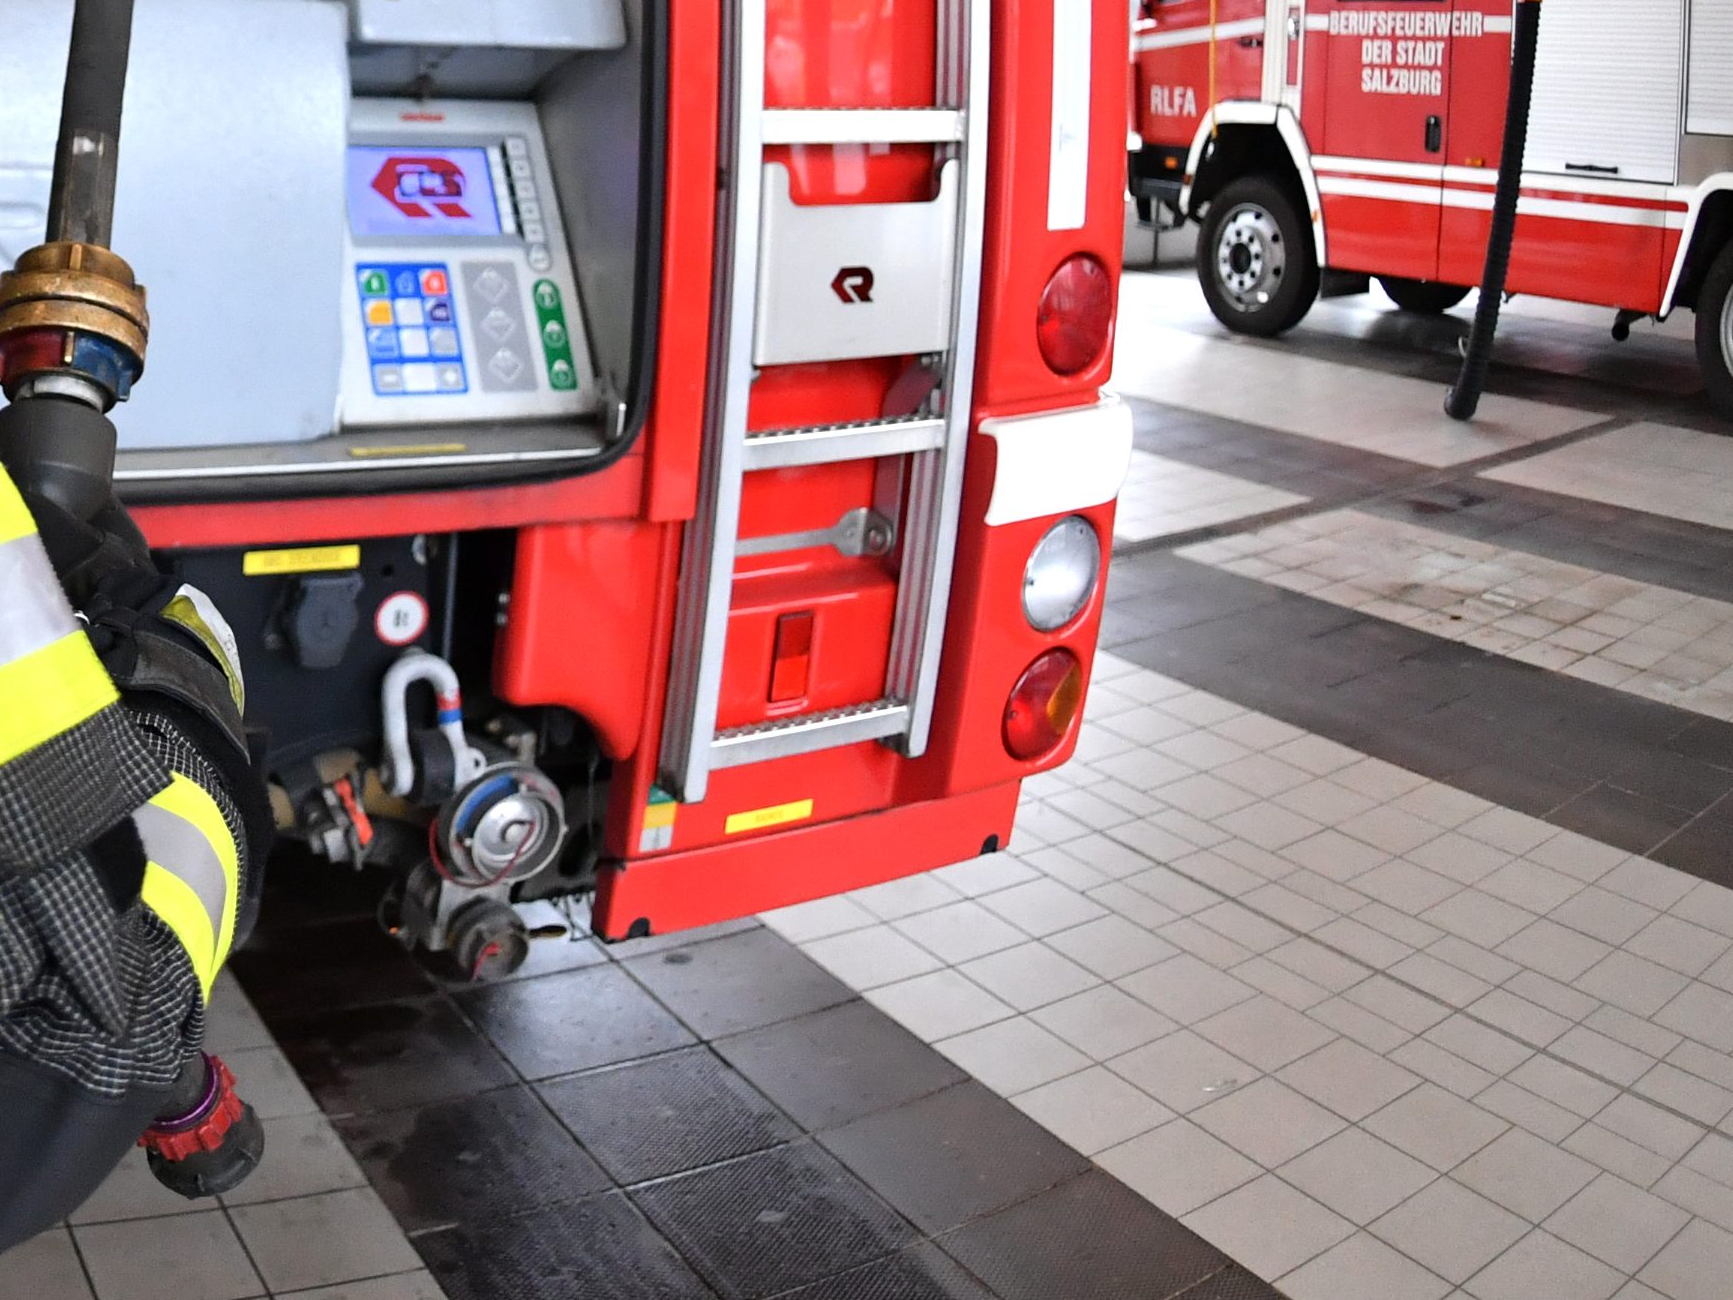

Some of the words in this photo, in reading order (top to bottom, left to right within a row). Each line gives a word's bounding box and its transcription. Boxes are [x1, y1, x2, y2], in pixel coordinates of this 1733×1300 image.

[1329, 10, 1483, 37] BERUFSFEUERWEHR
[1361, 39, 1392, 65] DER
[1396, 40, 1445, 66] STADT
[1361, 67, 1443, 96] SALZBURG
[1150, 84, 1197, 118] RLFA
